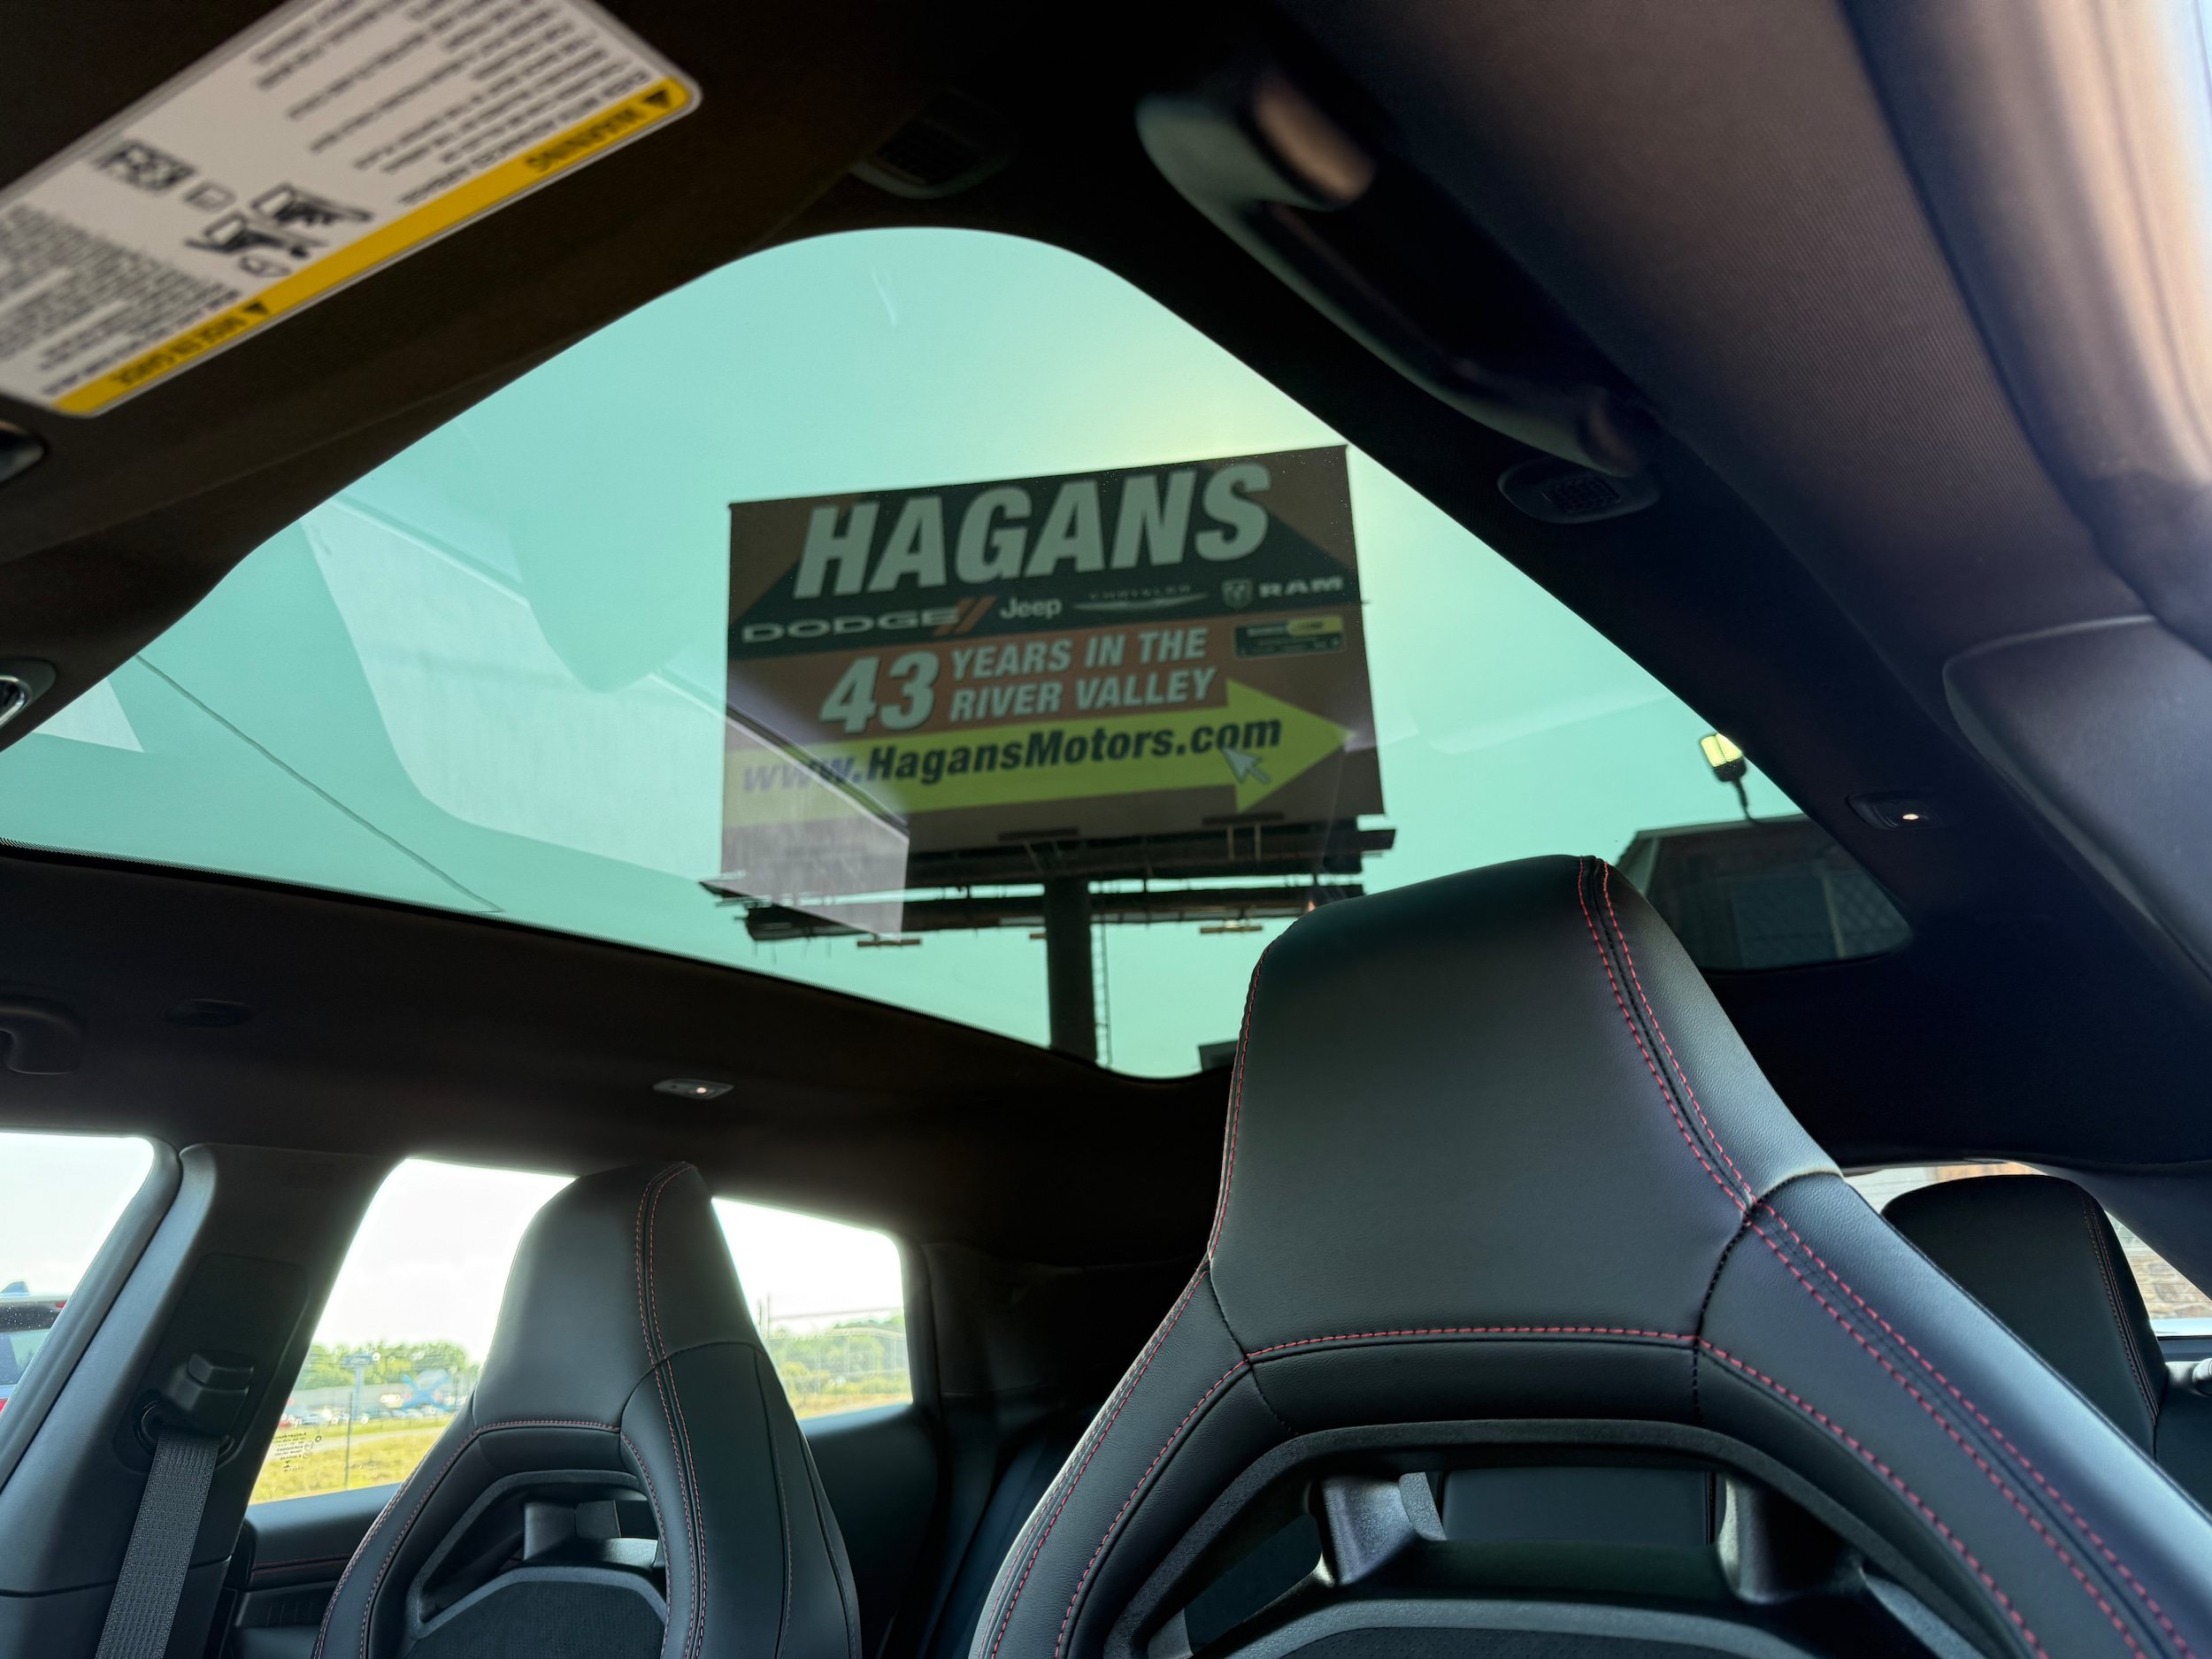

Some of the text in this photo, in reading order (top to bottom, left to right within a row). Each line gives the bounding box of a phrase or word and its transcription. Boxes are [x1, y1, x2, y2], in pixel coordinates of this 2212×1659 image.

[526, 105, 645, 173] WARNING
[793, 463, 1272, 599] HAGANS
[999, 595, 1062, 619] Jeep
[1259, 577, 1343, 598] RAM
[741, 605, 961, 642] DODGE
[951, 637, 1073, 681] YEARS
[1084, 634, 1126, 668] IN
[1138, 626, 1210, 664] THE
[818, 650, 941, 733] 43
[949, 666, 1218, 722] RIVER VALLEY
[742, 713, 1282, 792] www.HagansMotors.com
